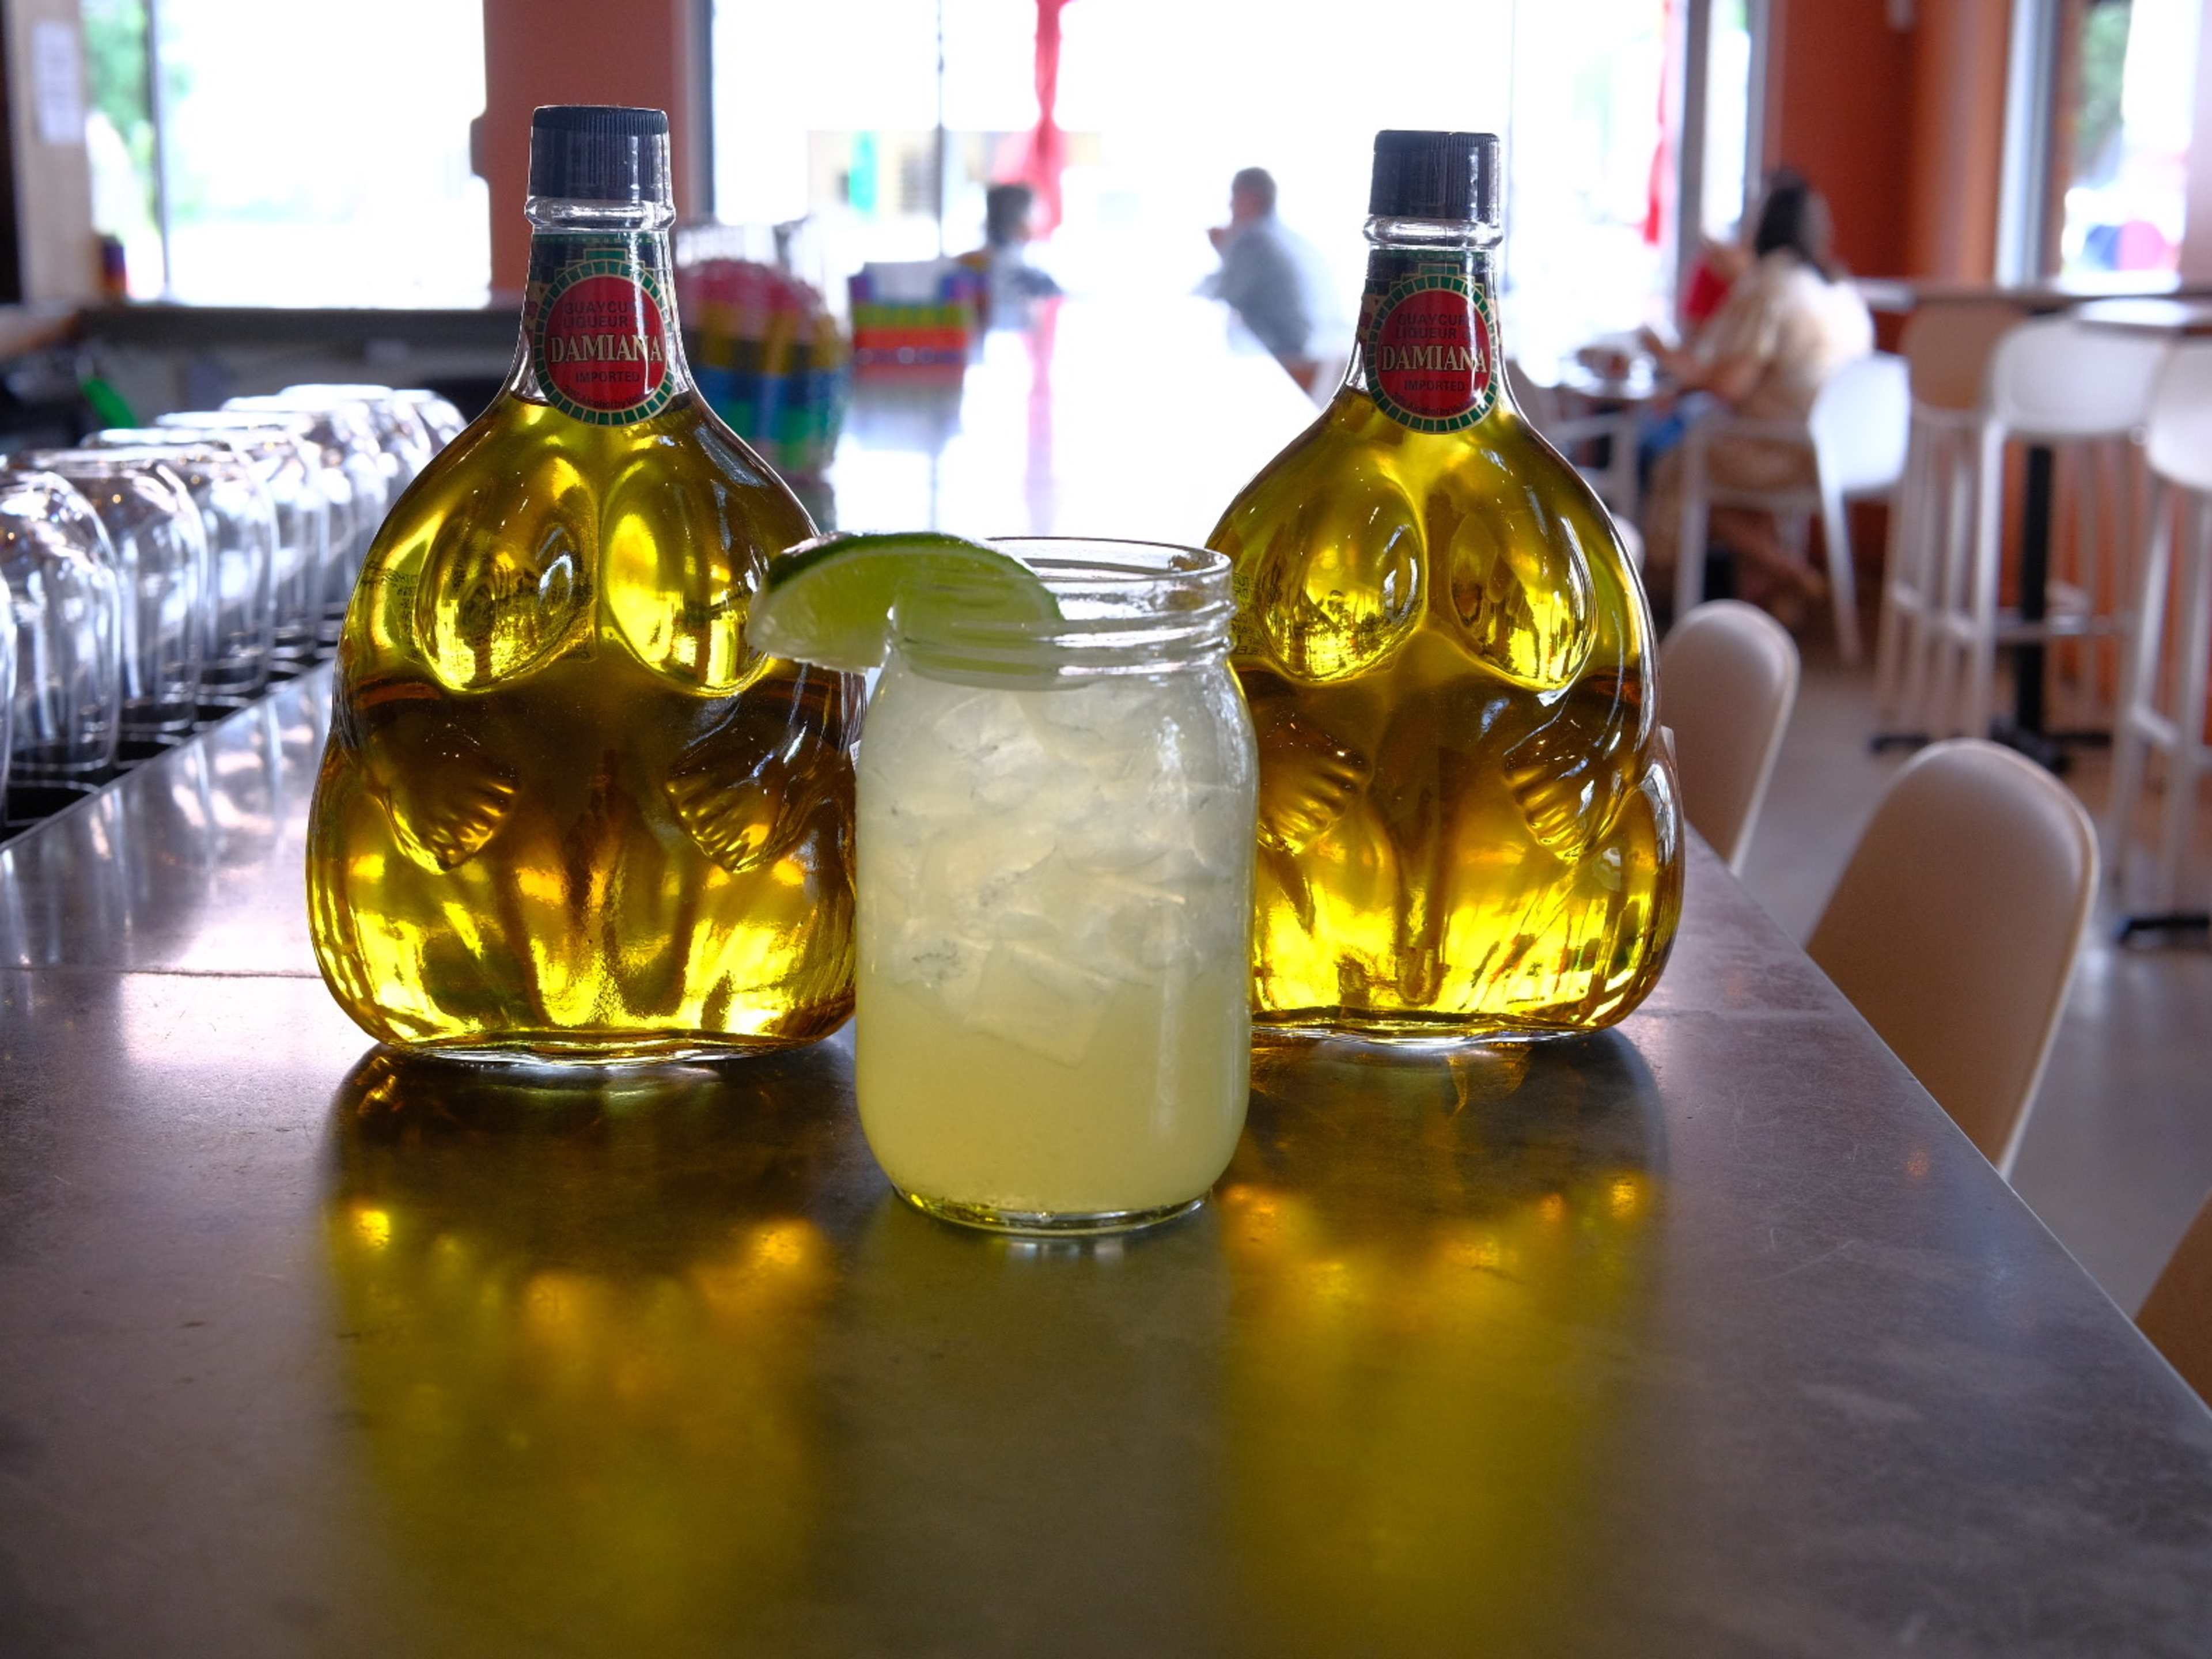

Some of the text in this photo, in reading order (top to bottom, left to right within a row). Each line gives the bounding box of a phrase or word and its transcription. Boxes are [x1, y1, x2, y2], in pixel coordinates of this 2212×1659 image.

[562, 315, 628, 328] LIQUEUR
[1396, 327, 1457, 339] LIQUEUR
[550, 334, 664, 363] DAMIANA
[1381, 344, 1488, 373] DAMIANA
[575, 370, 641, 383] IMPORTED
[1404, 380, 1467, 392] IMPORTED
